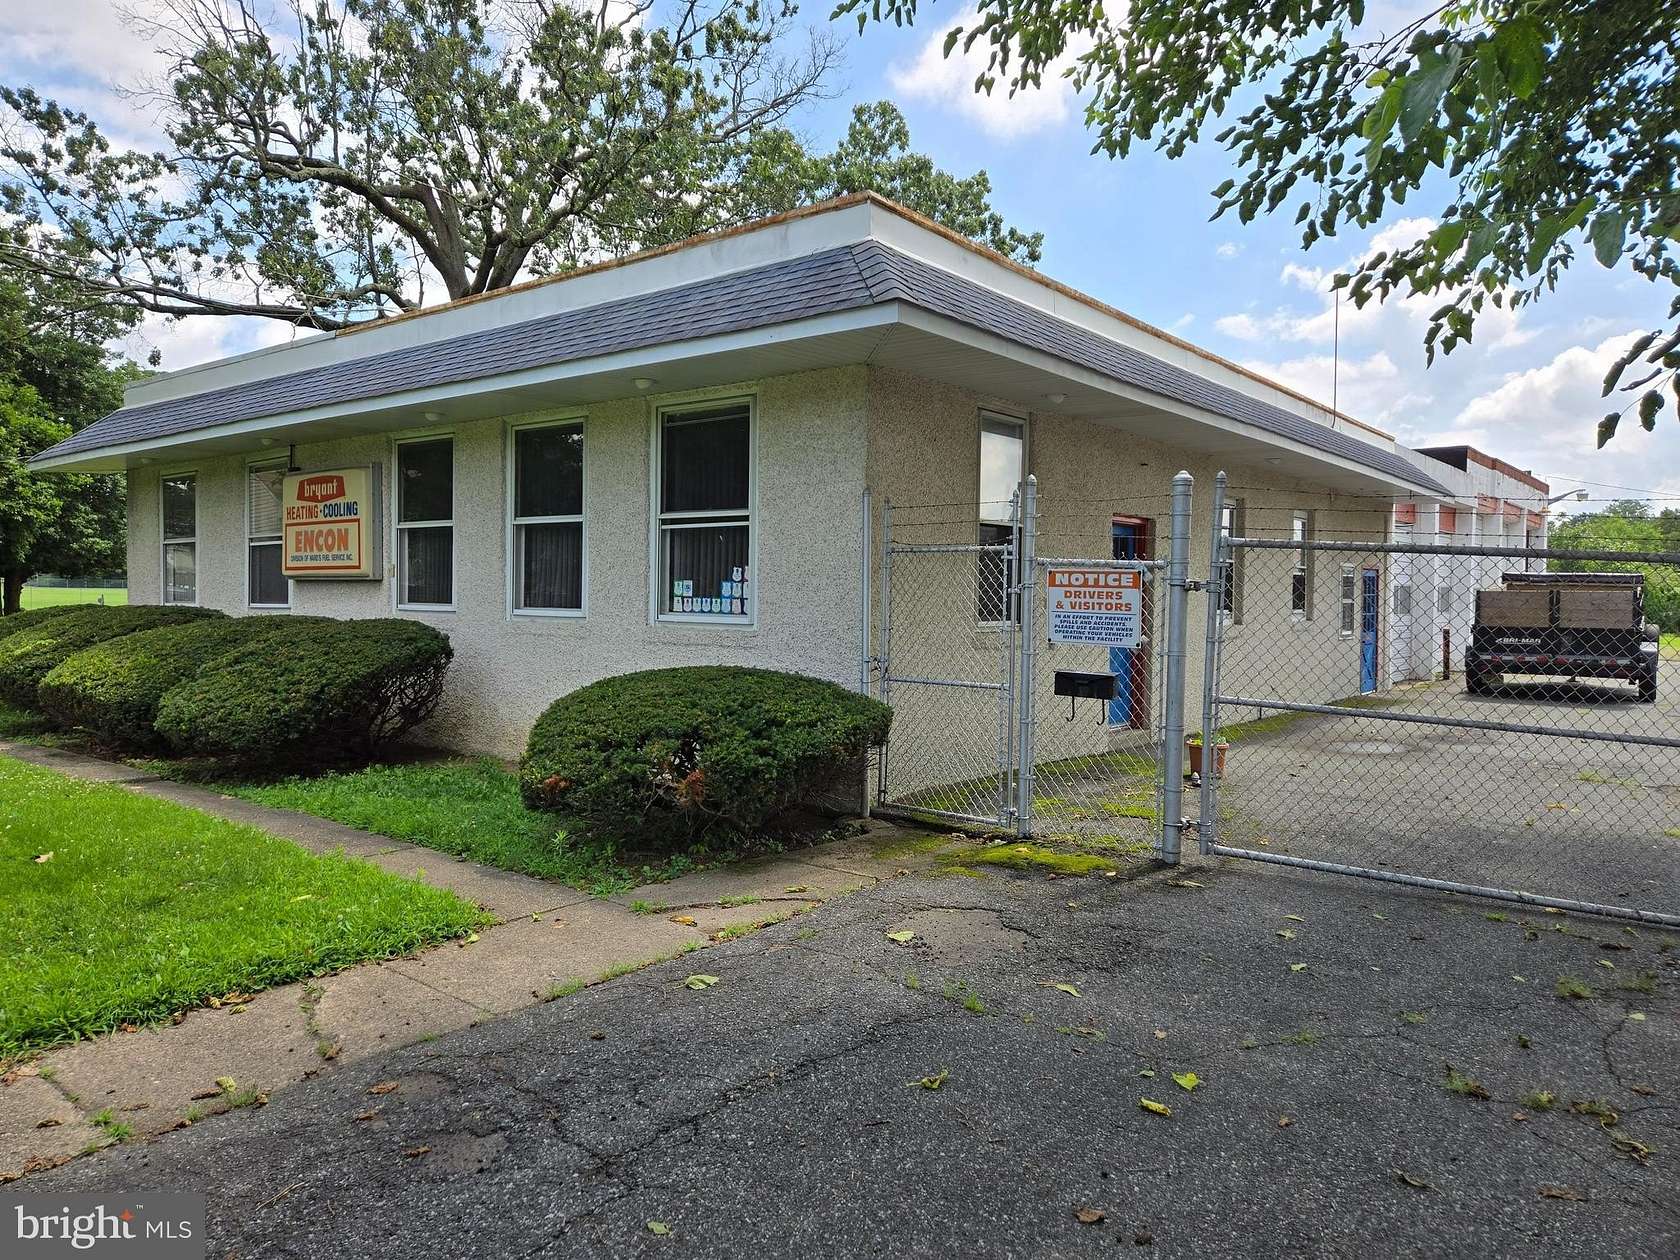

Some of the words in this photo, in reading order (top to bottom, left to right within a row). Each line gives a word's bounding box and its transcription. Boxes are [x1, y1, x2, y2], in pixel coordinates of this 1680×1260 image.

[304, 479, 338, 500] bryant
[286, 505, 319, 520] HEATING
[323, 501, 358, 518] COOLING
[295, 528, 349, 552] ENCON
[1055, 573, 1134, 586] NOTICE
[1064, 590, 1123, 600] DRIVERS
[1055, 601, 1064, 610] &
[1070, 602, 1133, 612] VISITORS
